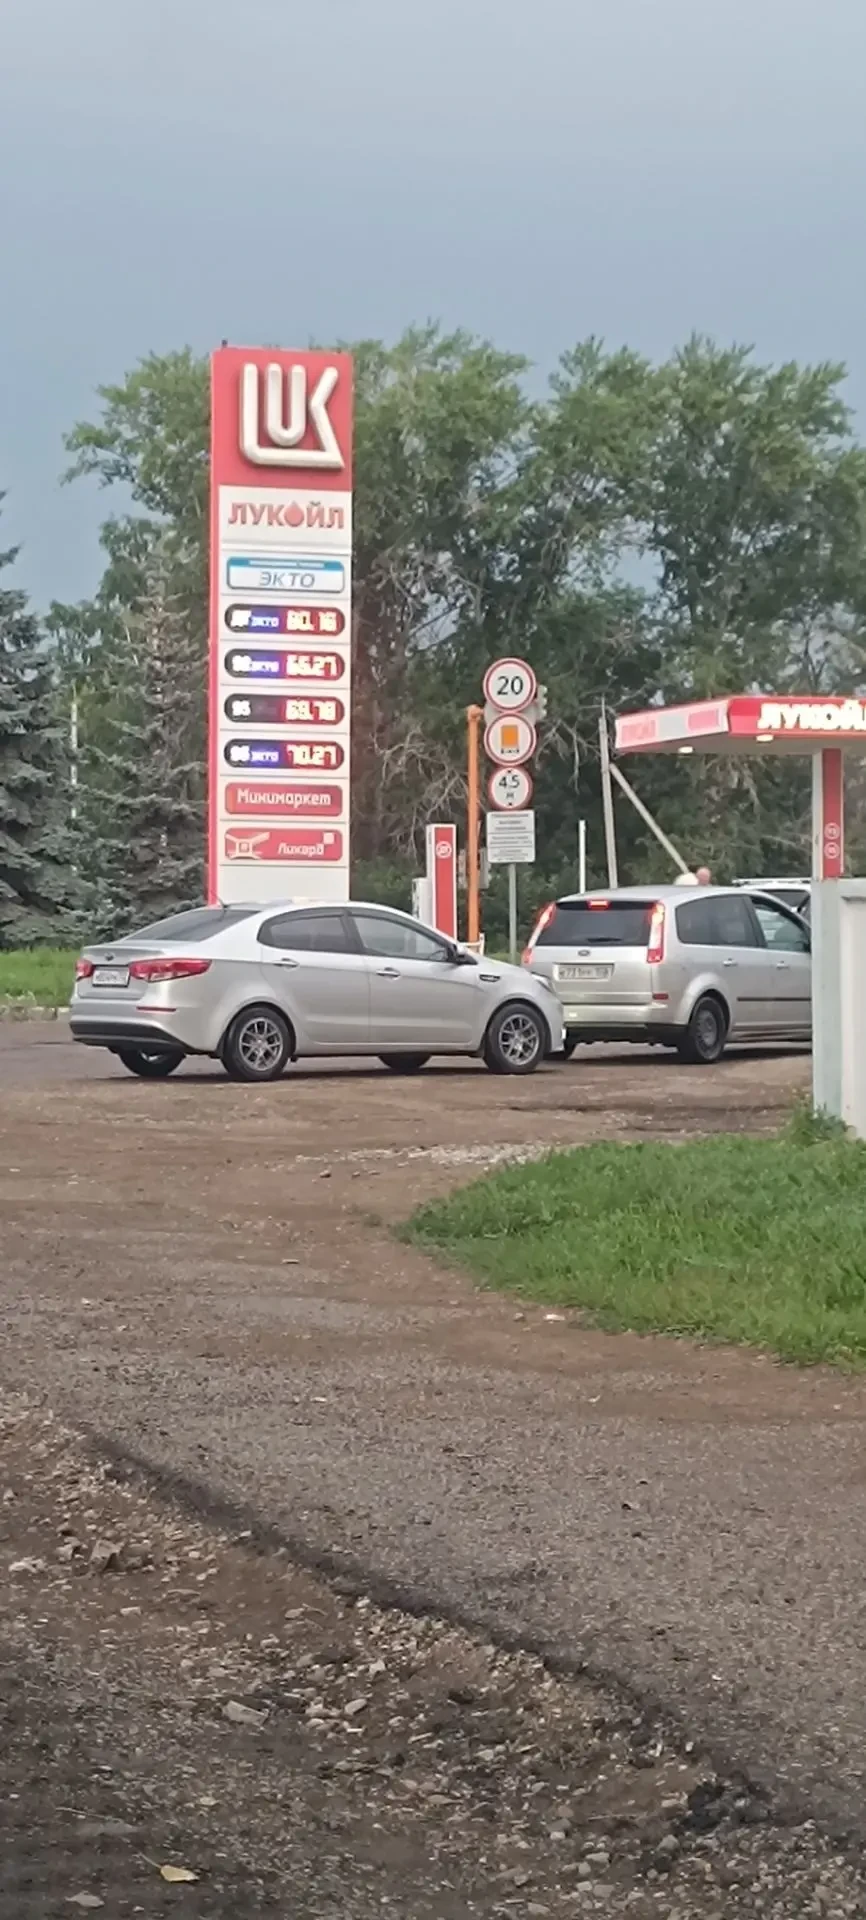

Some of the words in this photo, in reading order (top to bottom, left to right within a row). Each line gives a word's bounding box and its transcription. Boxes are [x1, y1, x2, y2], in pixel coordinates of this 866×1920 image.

[497, 676, 524, 695] 20
[757, 699, 866, 730] ЛУКОЙ
[237, 788, 331, 808] Минимаркет
